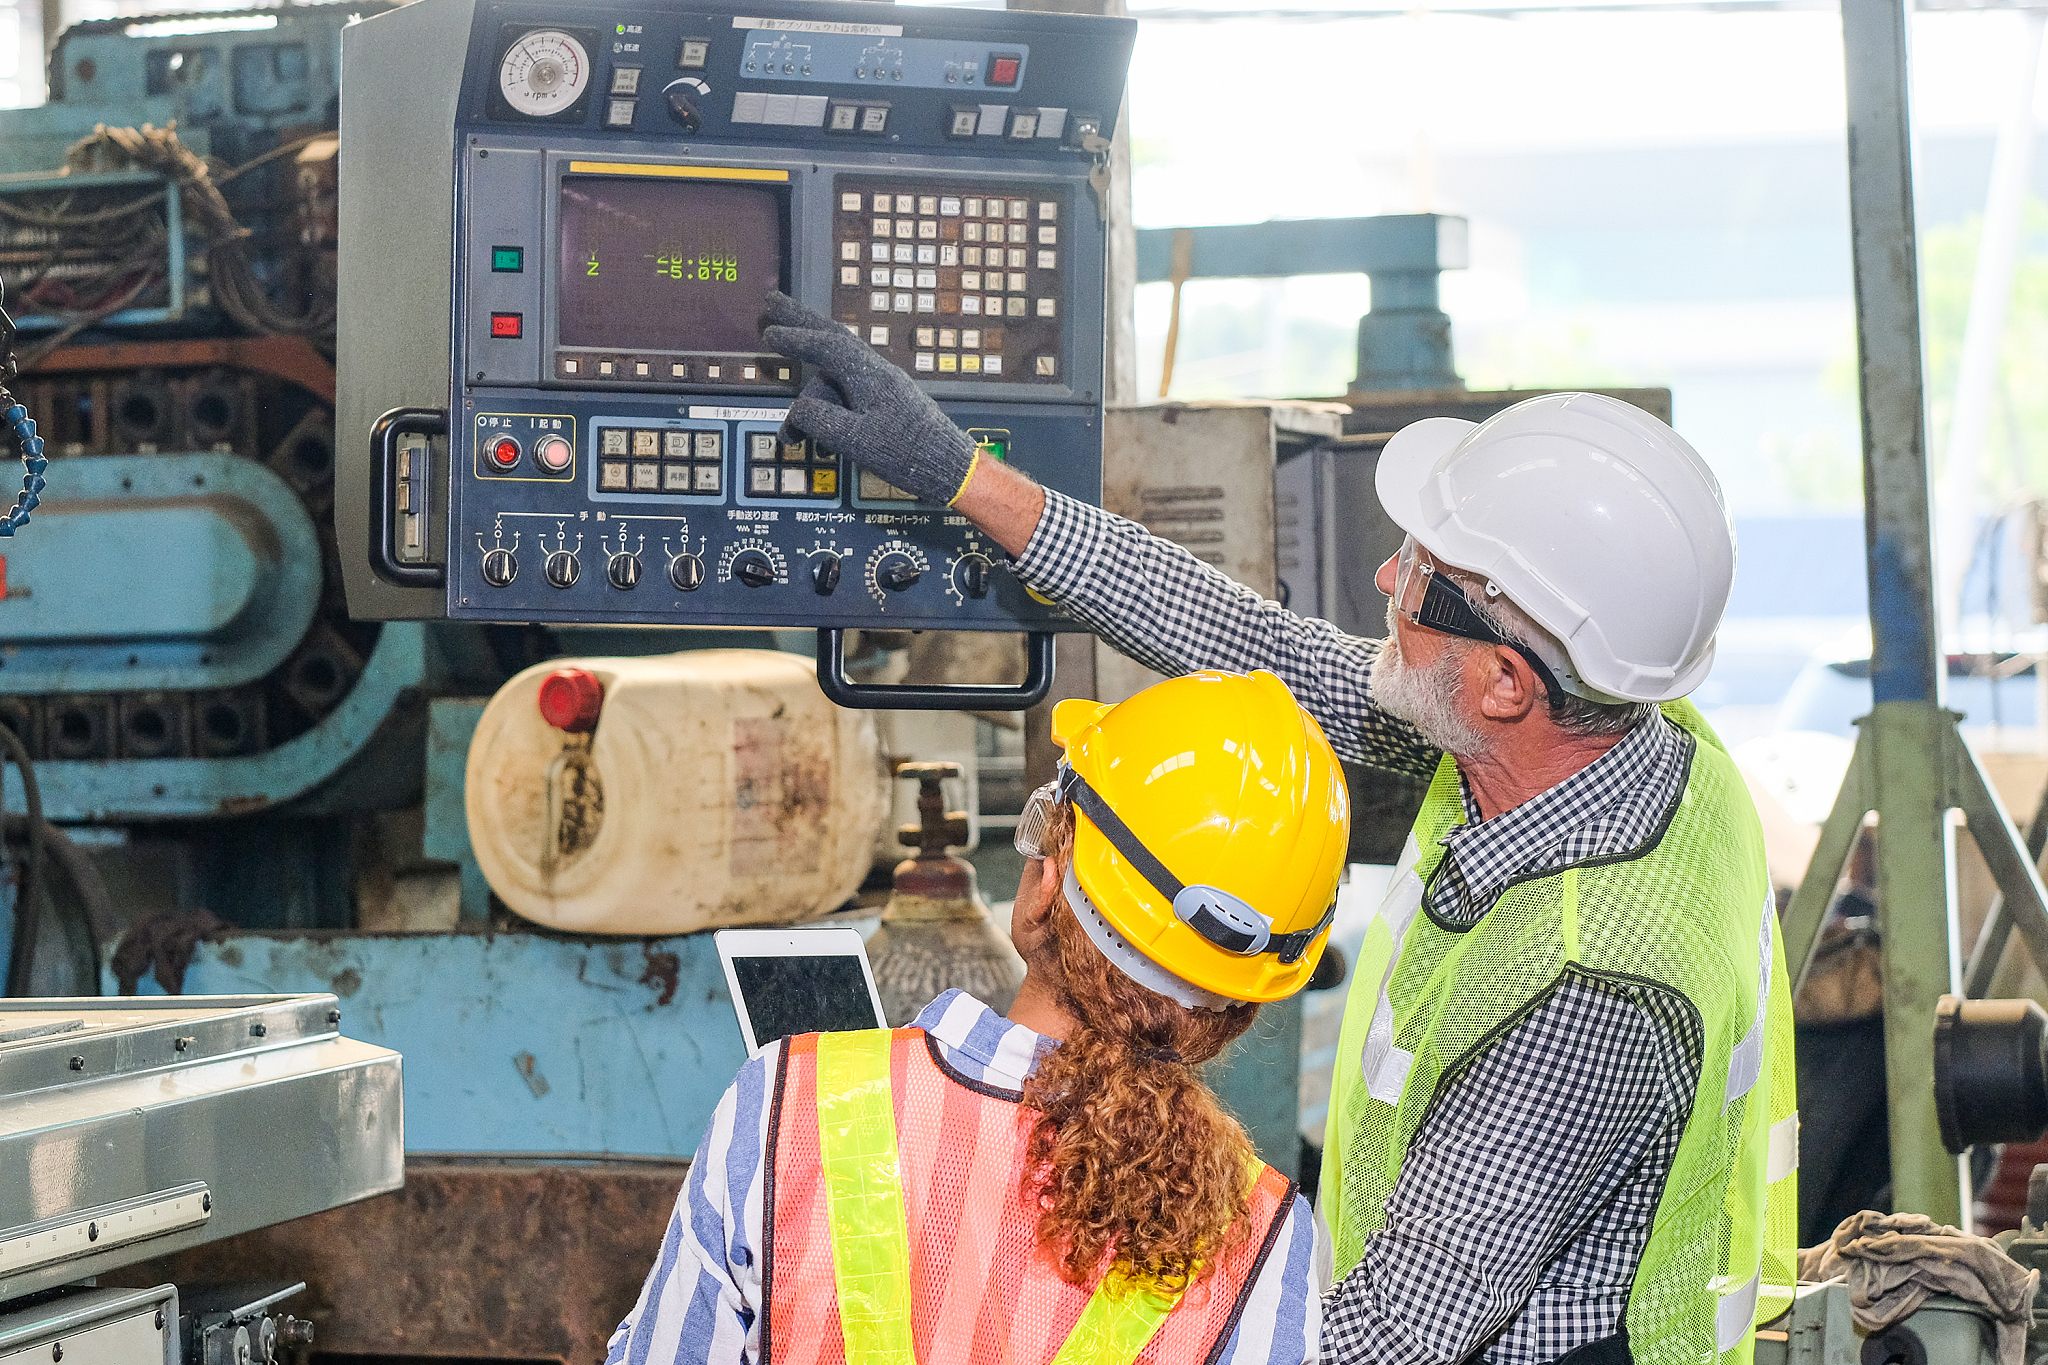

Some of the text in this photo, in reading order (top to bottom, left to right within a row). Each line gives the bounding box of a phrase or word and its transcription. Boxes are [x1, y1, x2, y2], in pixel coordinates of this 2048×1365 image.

[532, 92, 548, 101] rpm
[944, 246, 954, 261] F
[587, 261, 738, 282] Z -5.070
[875, 273, 883, 281] M
[878, 297, 884, 305] P
[898, 297, 905, 306] Q
[579, 511, 607, 522] 手動
[727, 509, 779, 521] 手動送り速度
[795, 511, 856, 523] 早送りオーバーライド
[494, 519, 502, 529] X
[556, 521, 565, 530] Y
[619, 523, 627, 533] Z
[680, 524, 688, 534] 4
